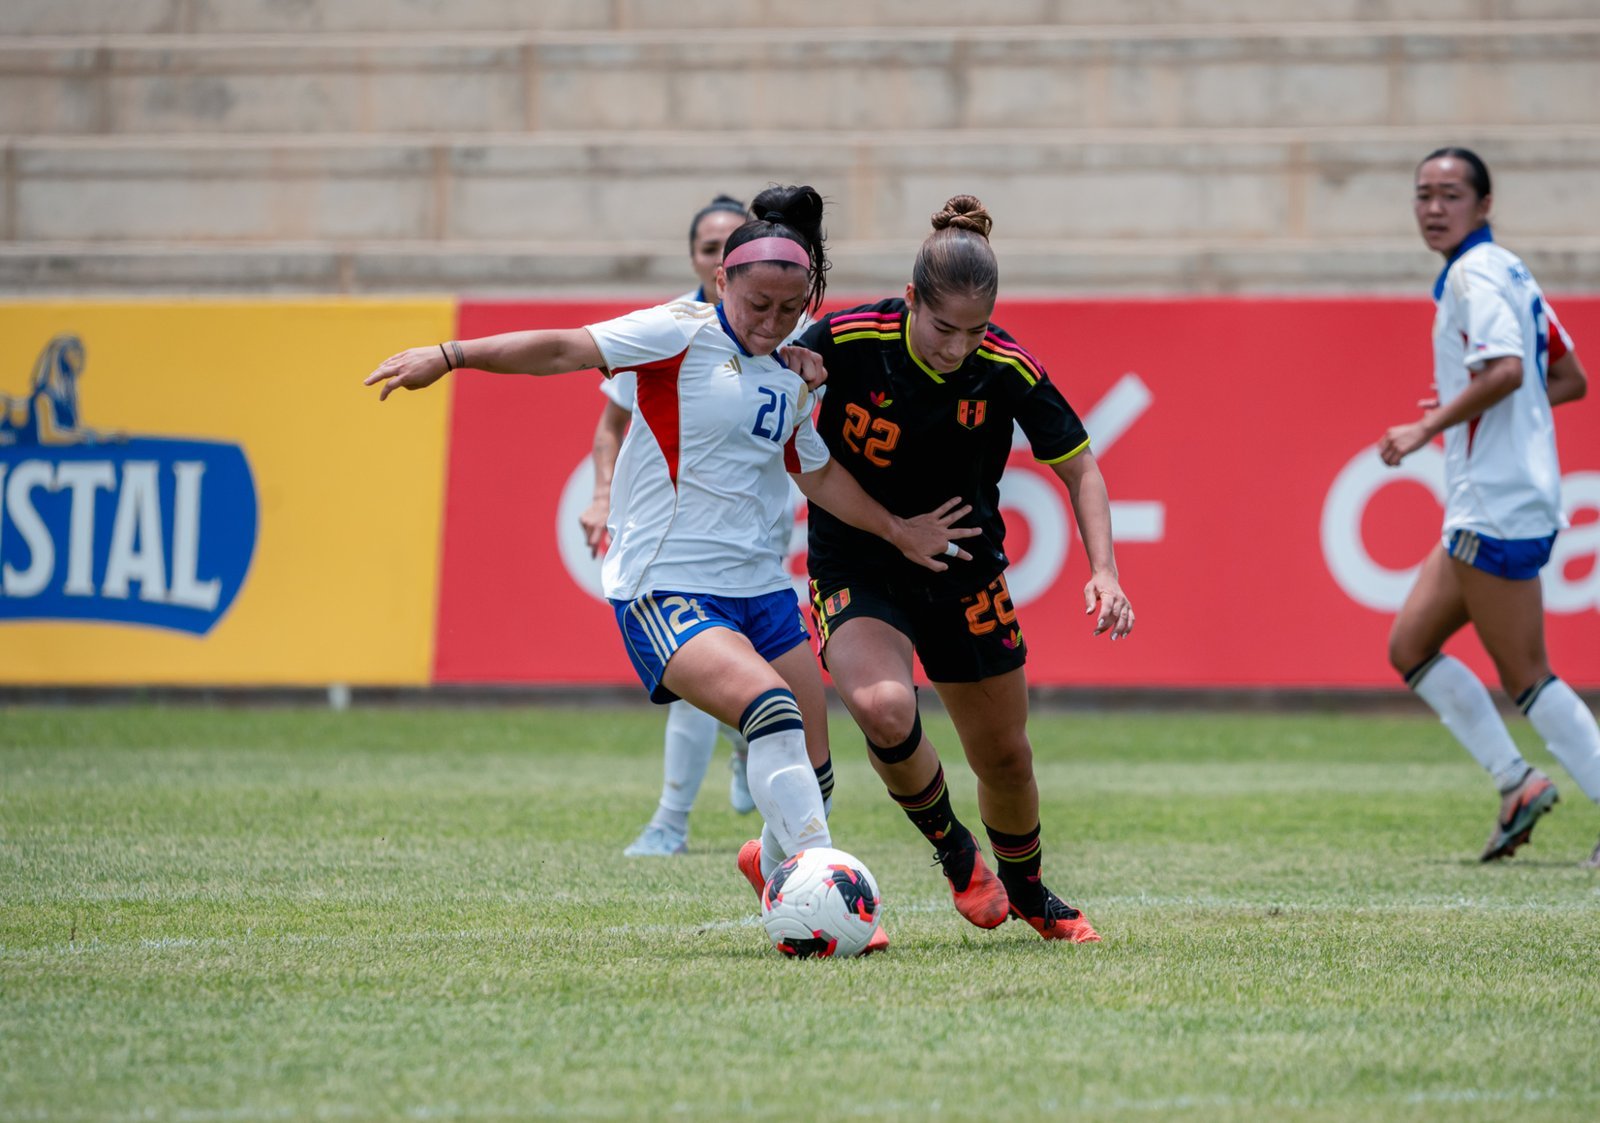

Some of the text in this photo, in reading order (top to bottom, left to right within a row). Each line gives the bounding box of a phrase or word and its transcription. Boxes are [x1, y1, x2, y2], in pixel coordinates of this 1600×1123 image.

[751, 386, 787, 442] 21
[842, 402, 901, 468] 22
[0, 458, 222, 612] STAL
[961, 573, 1016, 636] 22
